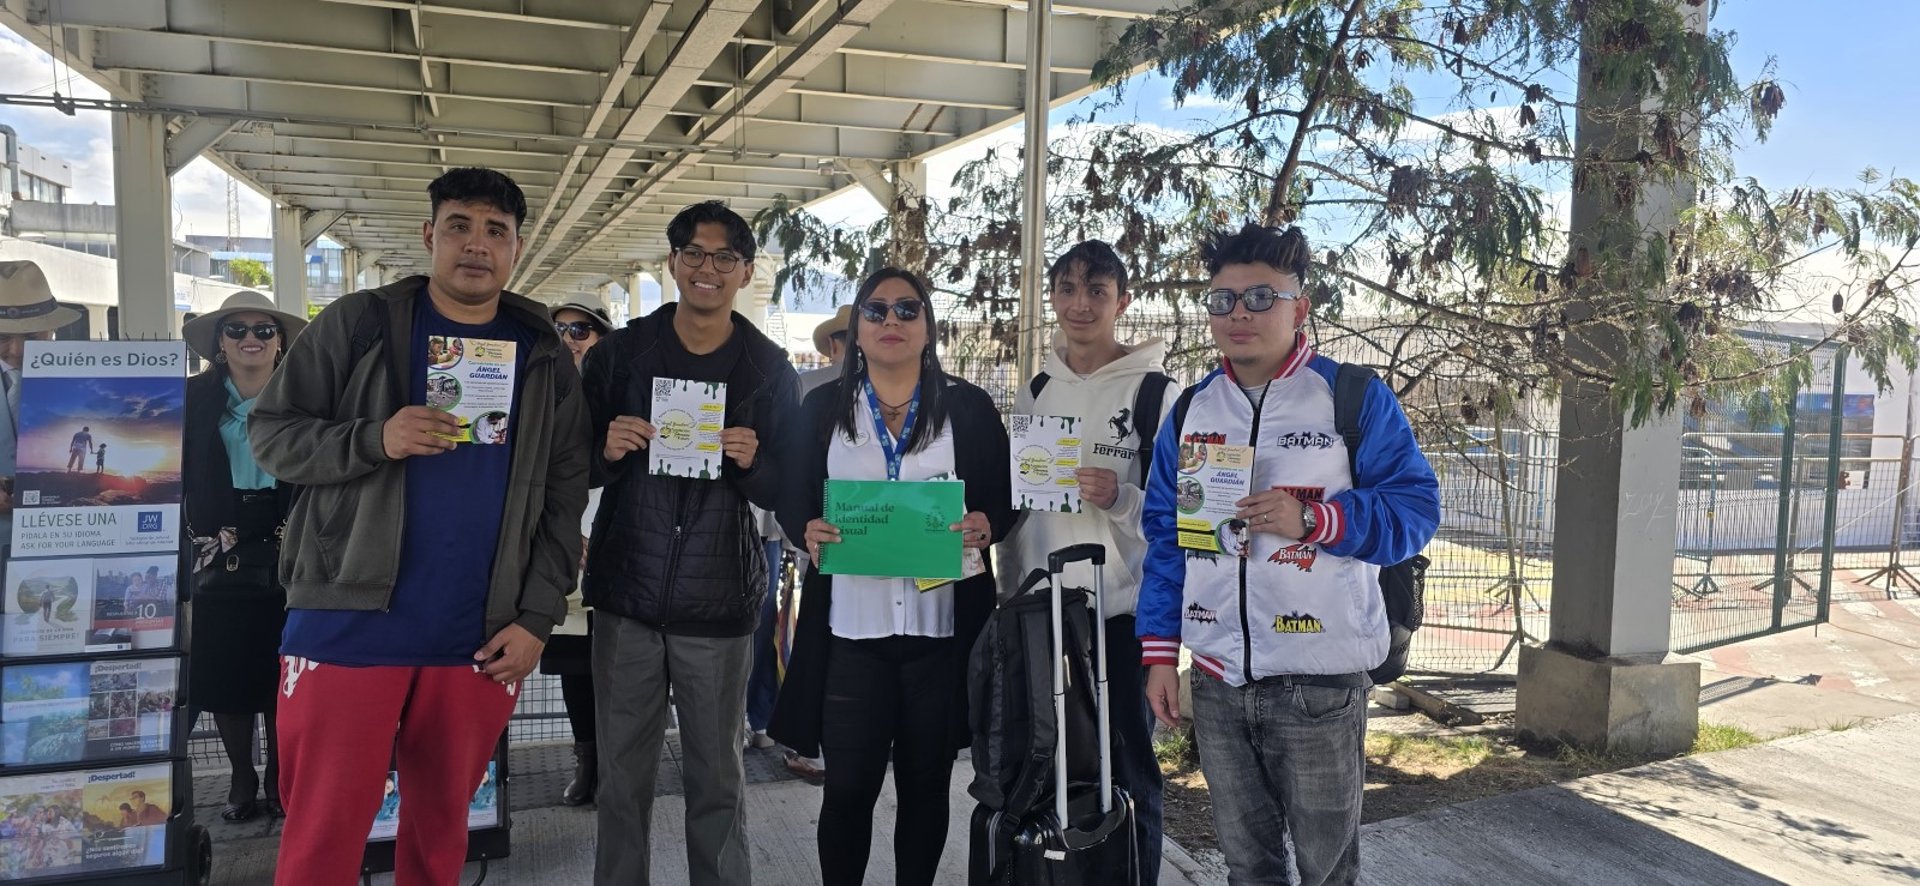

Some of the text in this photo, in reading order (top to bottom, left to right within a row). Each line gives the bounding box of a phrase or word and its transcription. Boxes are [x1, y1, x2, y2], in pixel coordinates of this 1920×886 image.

[30, 351, 179, 369] ¿Quién es Dios?
[1277, 435, 1333, 447] BATMAN
[835, 502, 895, 513] Manual de
[21, 512, 117, 528] LLÉVESE UNA
[142, 514, 158, 523] JW
[75, 530, 101, 538] IDIOMA
[840, 526, 867, 535] isual
[77, 539, 116, 548] LANGUAGE
[1279, 548, 1313, 560] BATMAN
[136, 603, 157, 620] 10
[1276, 615, 1322, 633] BATMAN
[88, 771, 135, 783] ¡Despertad!
